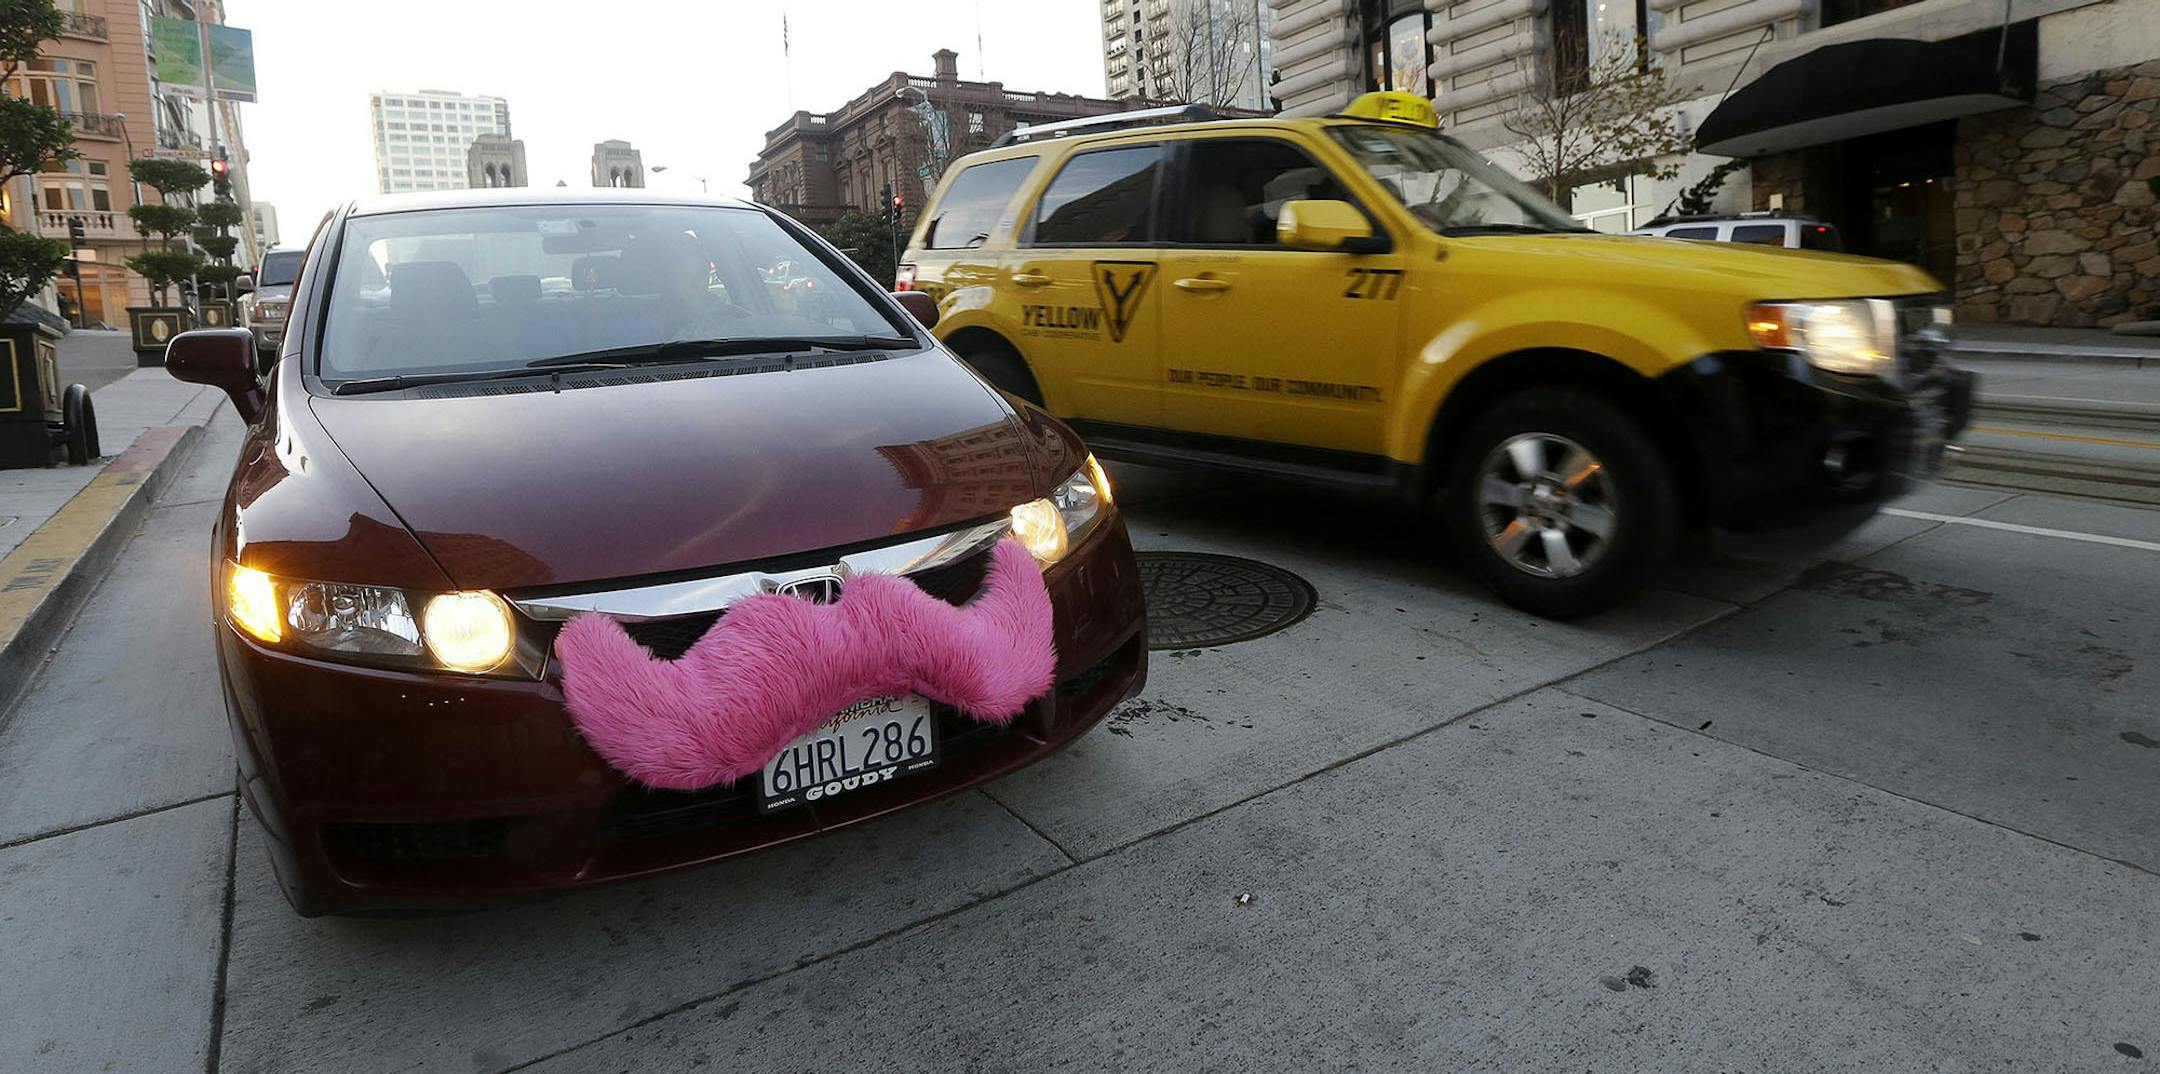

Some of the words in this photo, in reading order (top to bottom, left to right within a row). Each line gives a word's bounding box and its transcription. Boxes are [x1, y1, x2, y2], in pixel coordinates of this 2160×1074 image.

[1343, 267, 1408, 301] 277
[1021, 304, 1102, 331] YELLOW
[1167, 368, 1193, 385] OUR
[1253, 376, 1282, 393] OUR
[772, 714, 926, 795] 6HRL286
[766, 797, 797, 810] HONDA
[805, 765, 898, 801] GOUDY
[907, 759, 934, 771] HONDA
